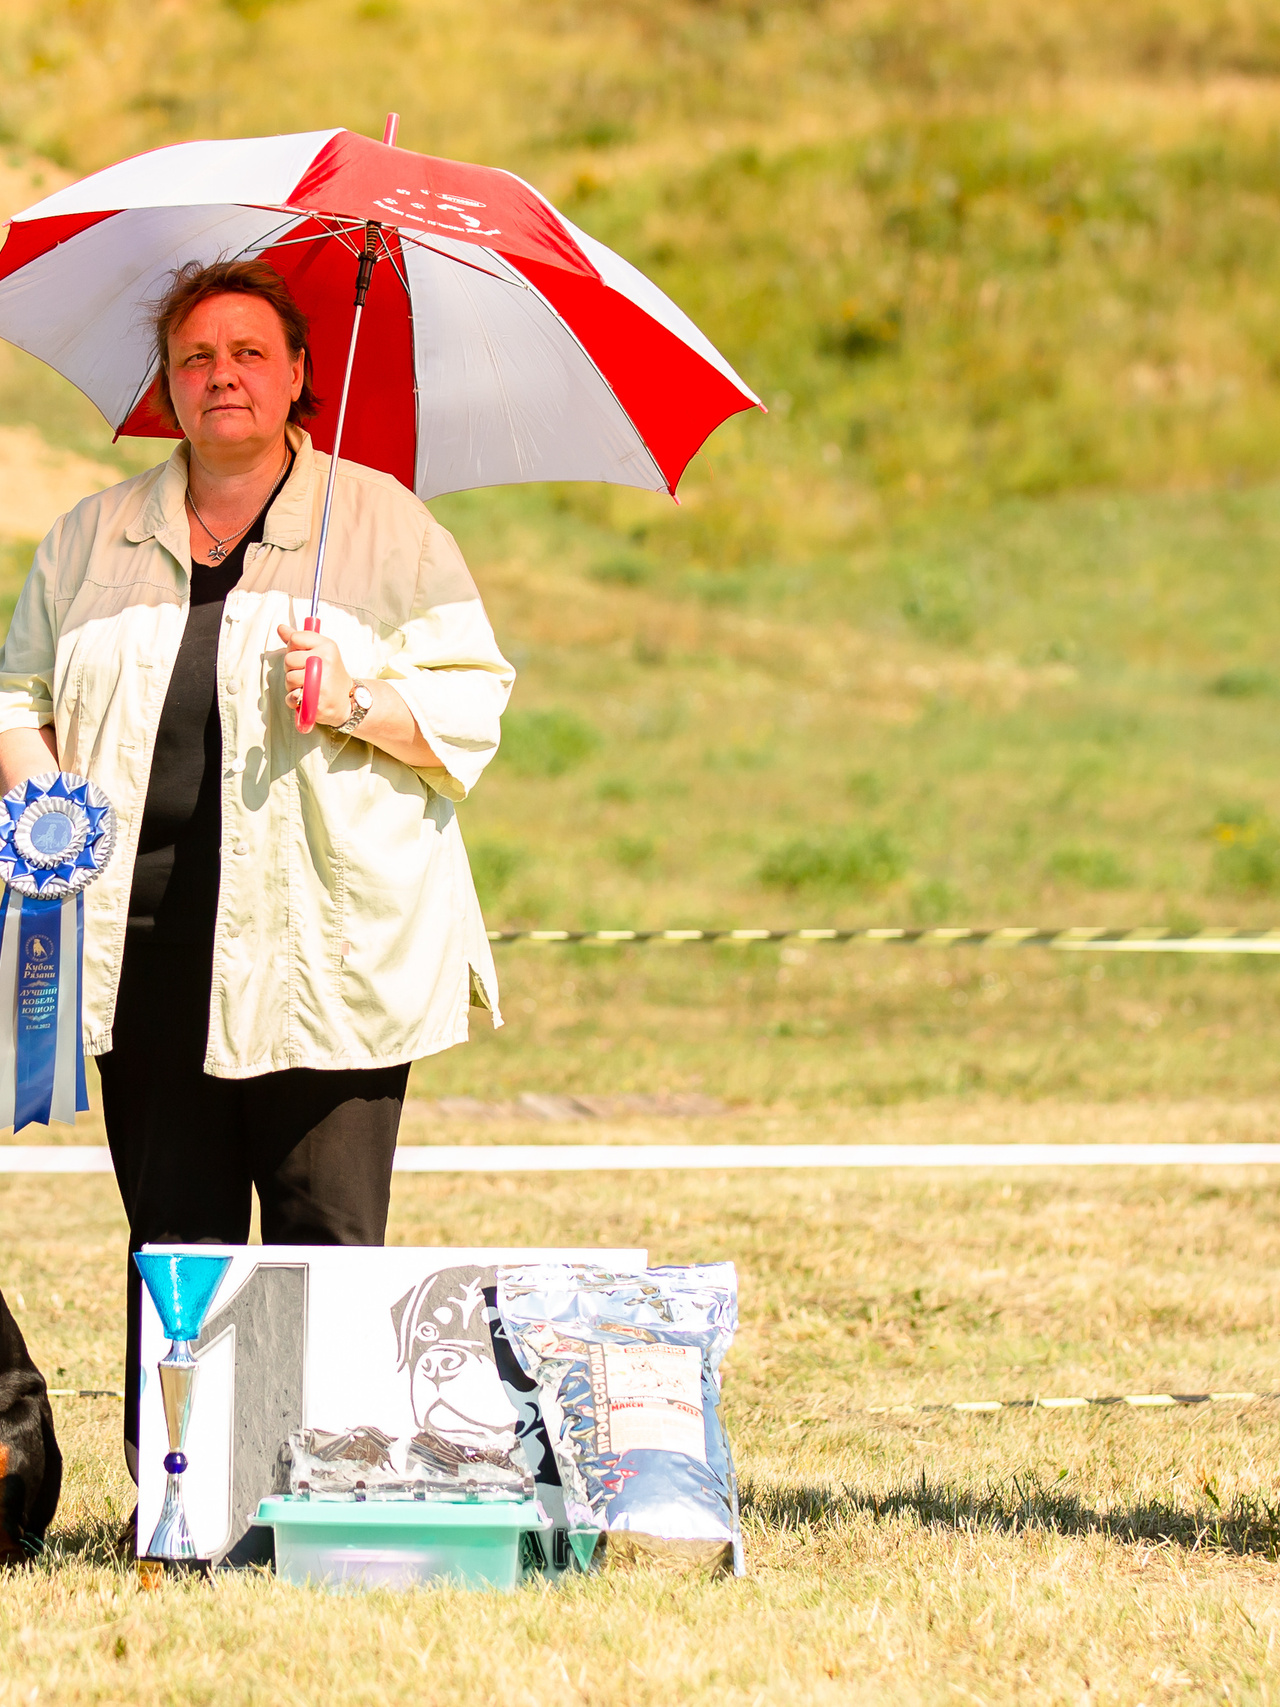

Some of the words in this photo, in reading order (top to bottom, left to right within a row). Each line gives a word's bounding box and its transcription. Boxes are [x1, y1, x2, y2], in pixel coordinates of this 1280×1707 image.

[25, 963, 55, 972] Кубок
[23, 971, 56, 979] Рязани
[20, 987, 58, 996] ЛУЧШИЙ
[22, 997, 55, 1005] КОБЕЛЬ
[21, 1005, 55, 1014] ЮНИОР
[588, 1343, 611, 1455] ПРОФЕССИОНАЛ
[611, 1402, 644, 1412] МАКСИ
[676, 1403, 699, 1417] 24/12
[192, 1262, 310, 1567] 1
